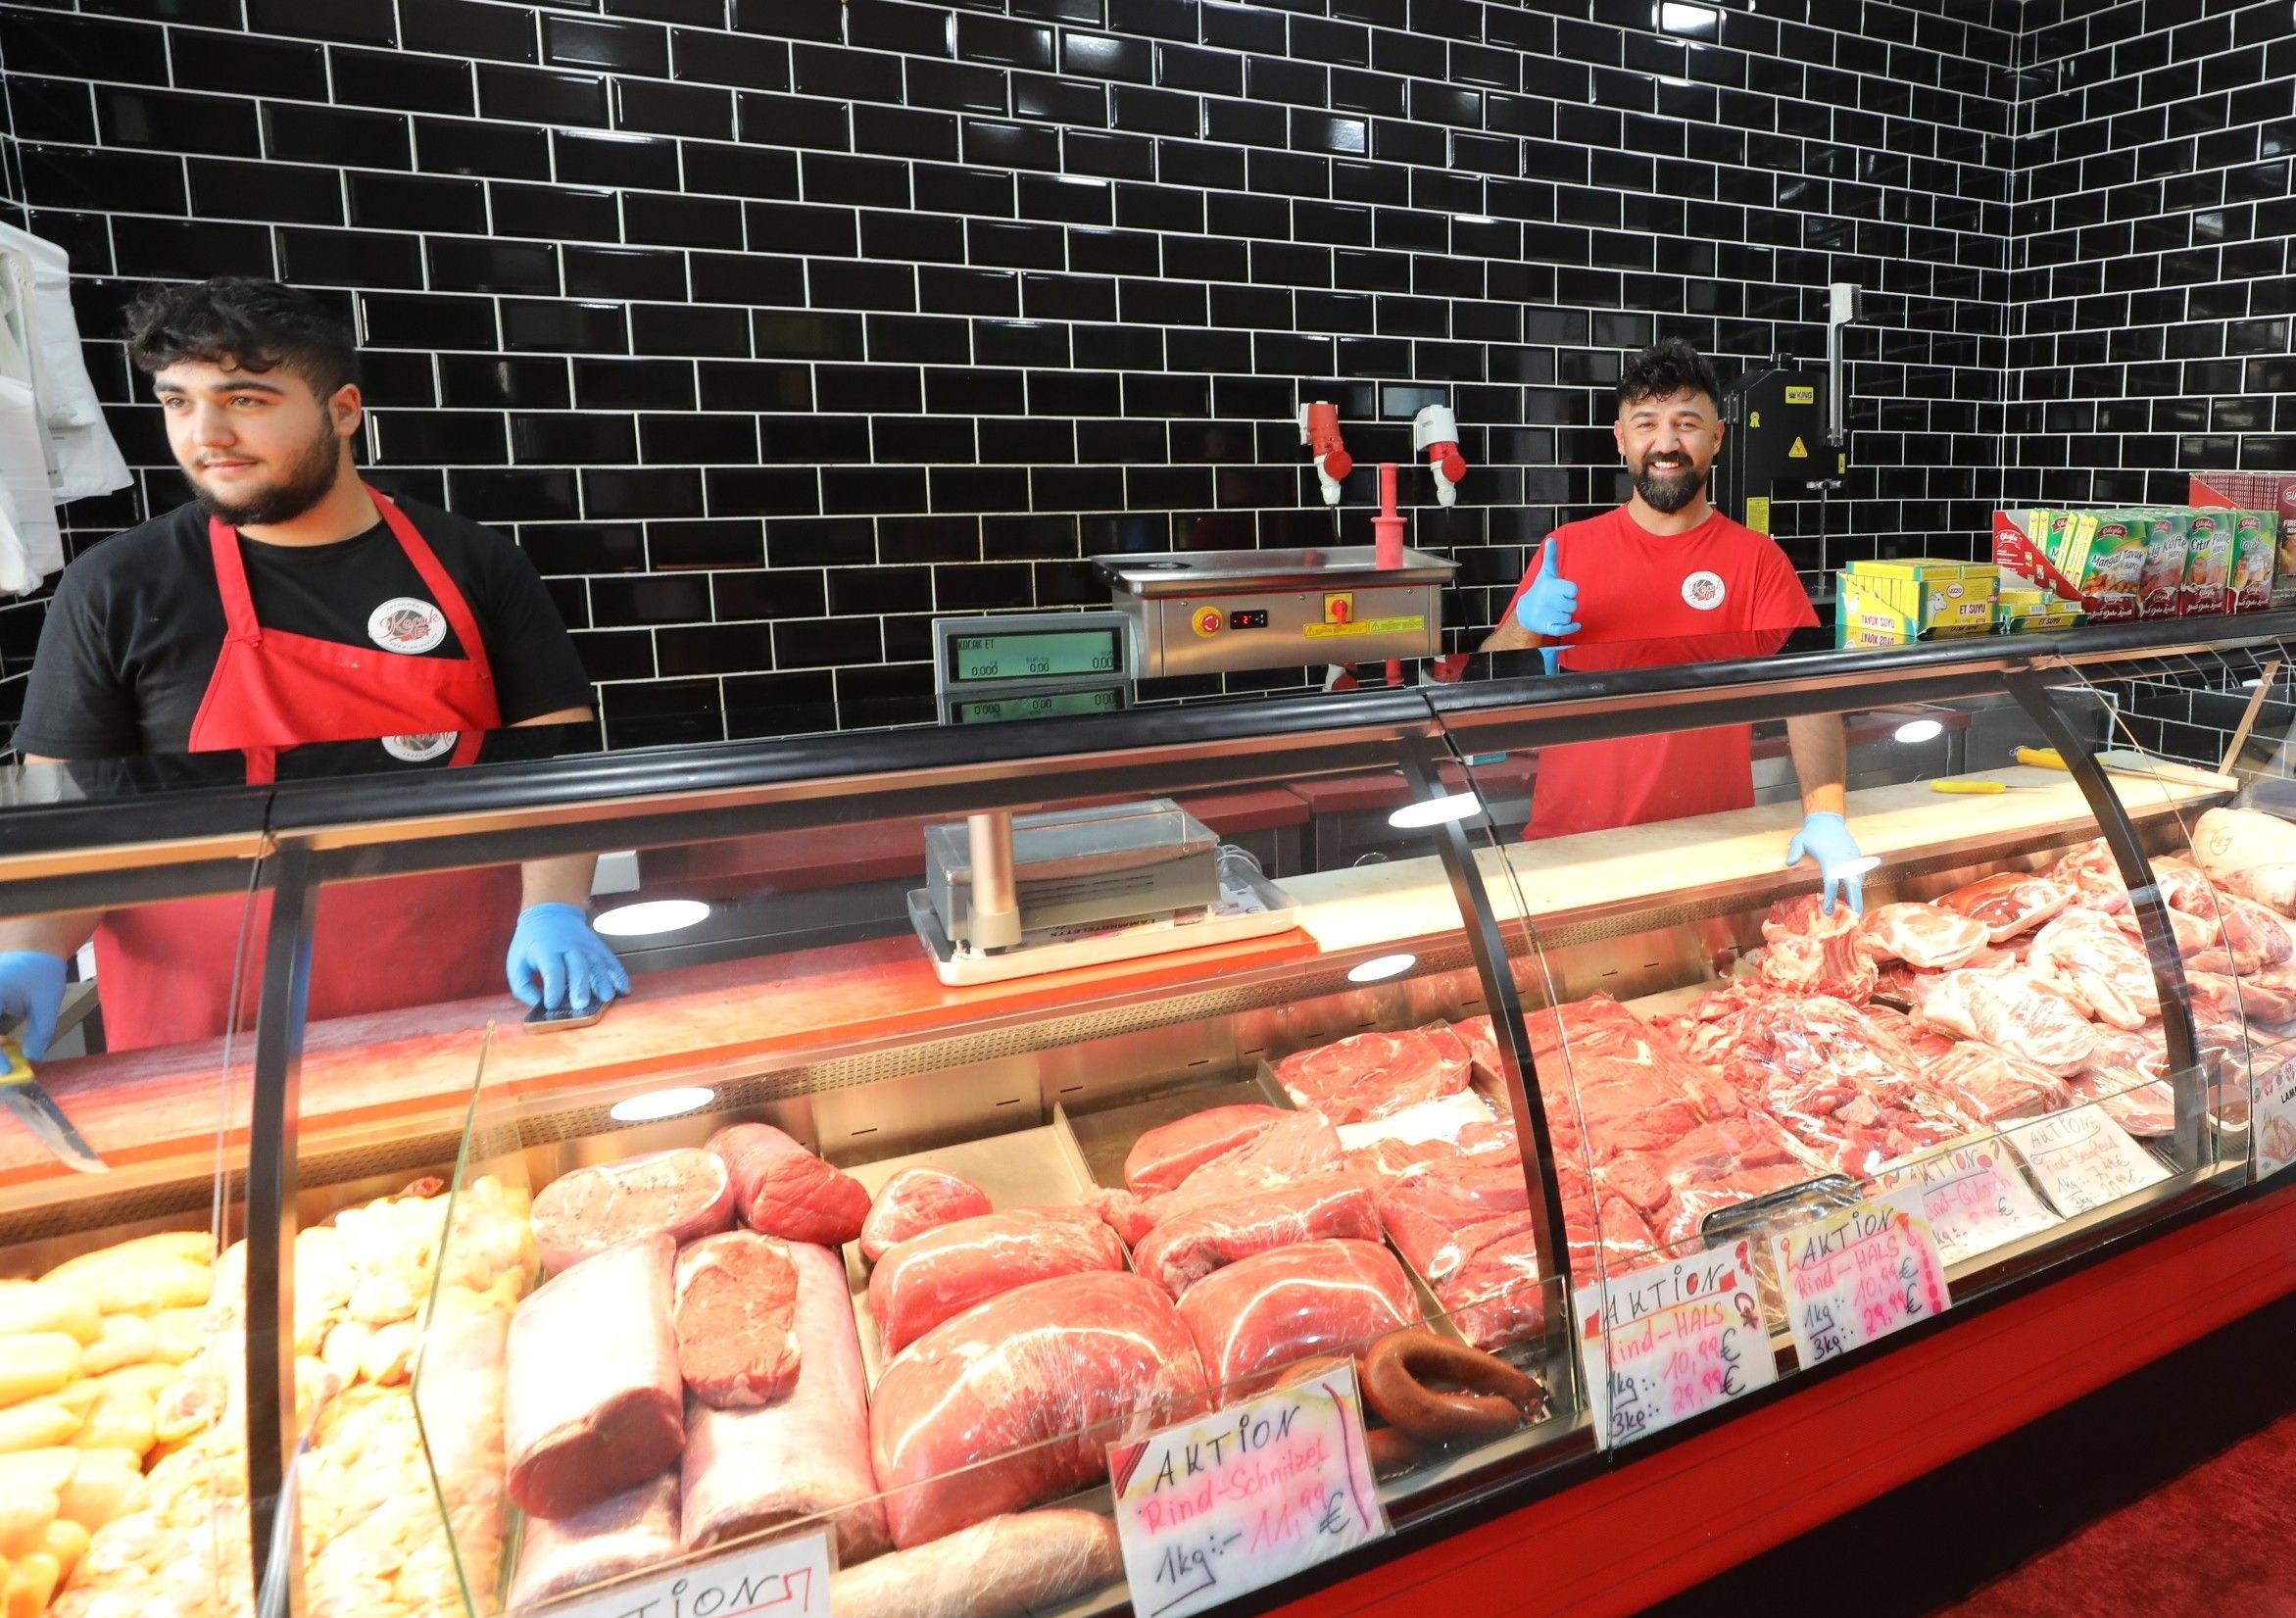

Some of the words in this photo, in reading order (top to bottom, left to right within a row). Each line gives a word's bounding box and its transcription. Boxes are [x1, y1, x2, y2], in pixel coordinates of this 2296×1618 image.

[1797, 391, 1813, 400] KING
[2091, 551, 2123, 568] Mangal
[1959, 604, 1968, 614] ET
[1969, 603, 1985, 614] SUYU
[956, 638, 982, 651] KOCAK
[985, 638, 995, 650] ET
[2281, 1084, 2296, 1104] LAM
[1794, 1235, 1899, 1299] Rind-HALS
[1140, 1437, 1331, 1537] Rind-Schnitzel
